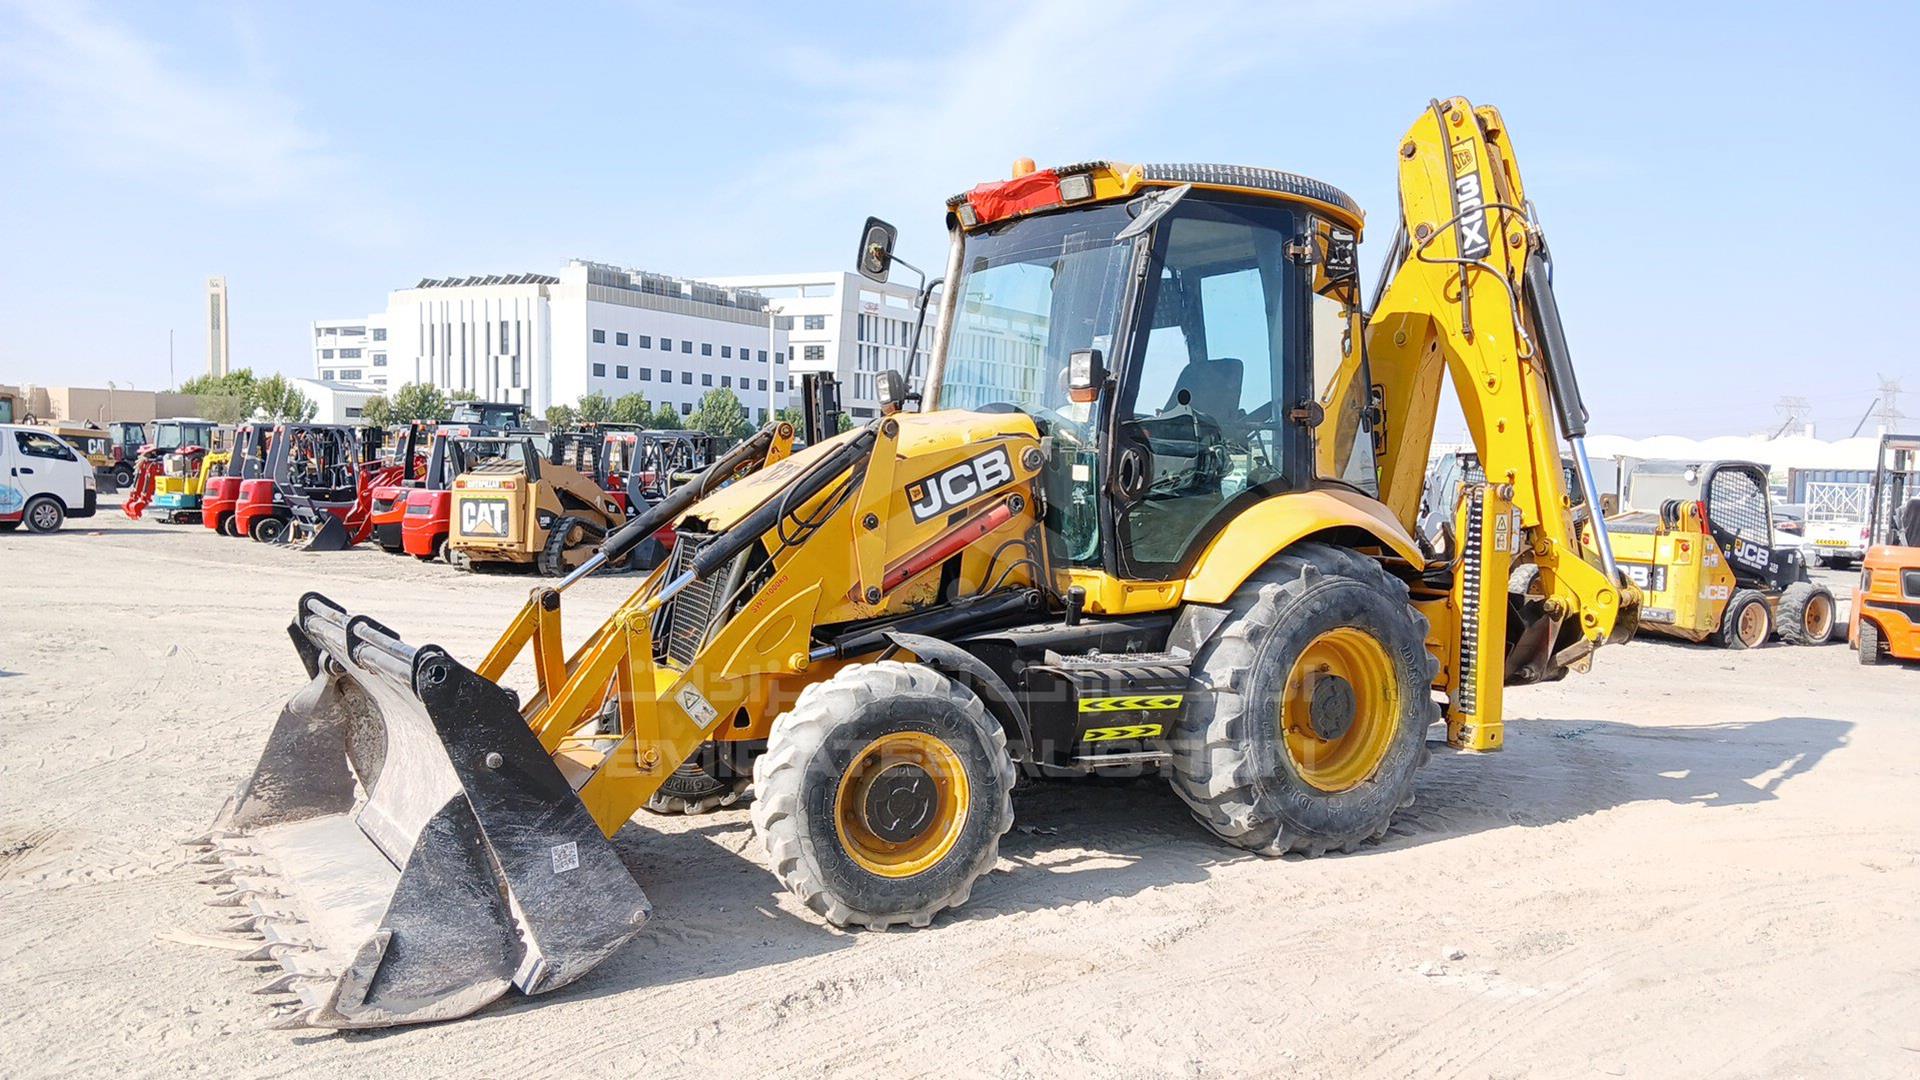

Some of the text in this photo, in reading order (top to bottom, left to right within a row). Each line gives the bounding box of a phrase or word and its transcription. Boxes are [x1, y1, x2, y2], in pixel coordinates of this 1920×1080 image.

[88, 439, 104, 454] CAT
[914, 450, 1011, 518] JCB
[463, 502, 506, 534] CAT
[1734, 542, 1769, 566] JCB
[1699, 585, 1728, 600] JCB
